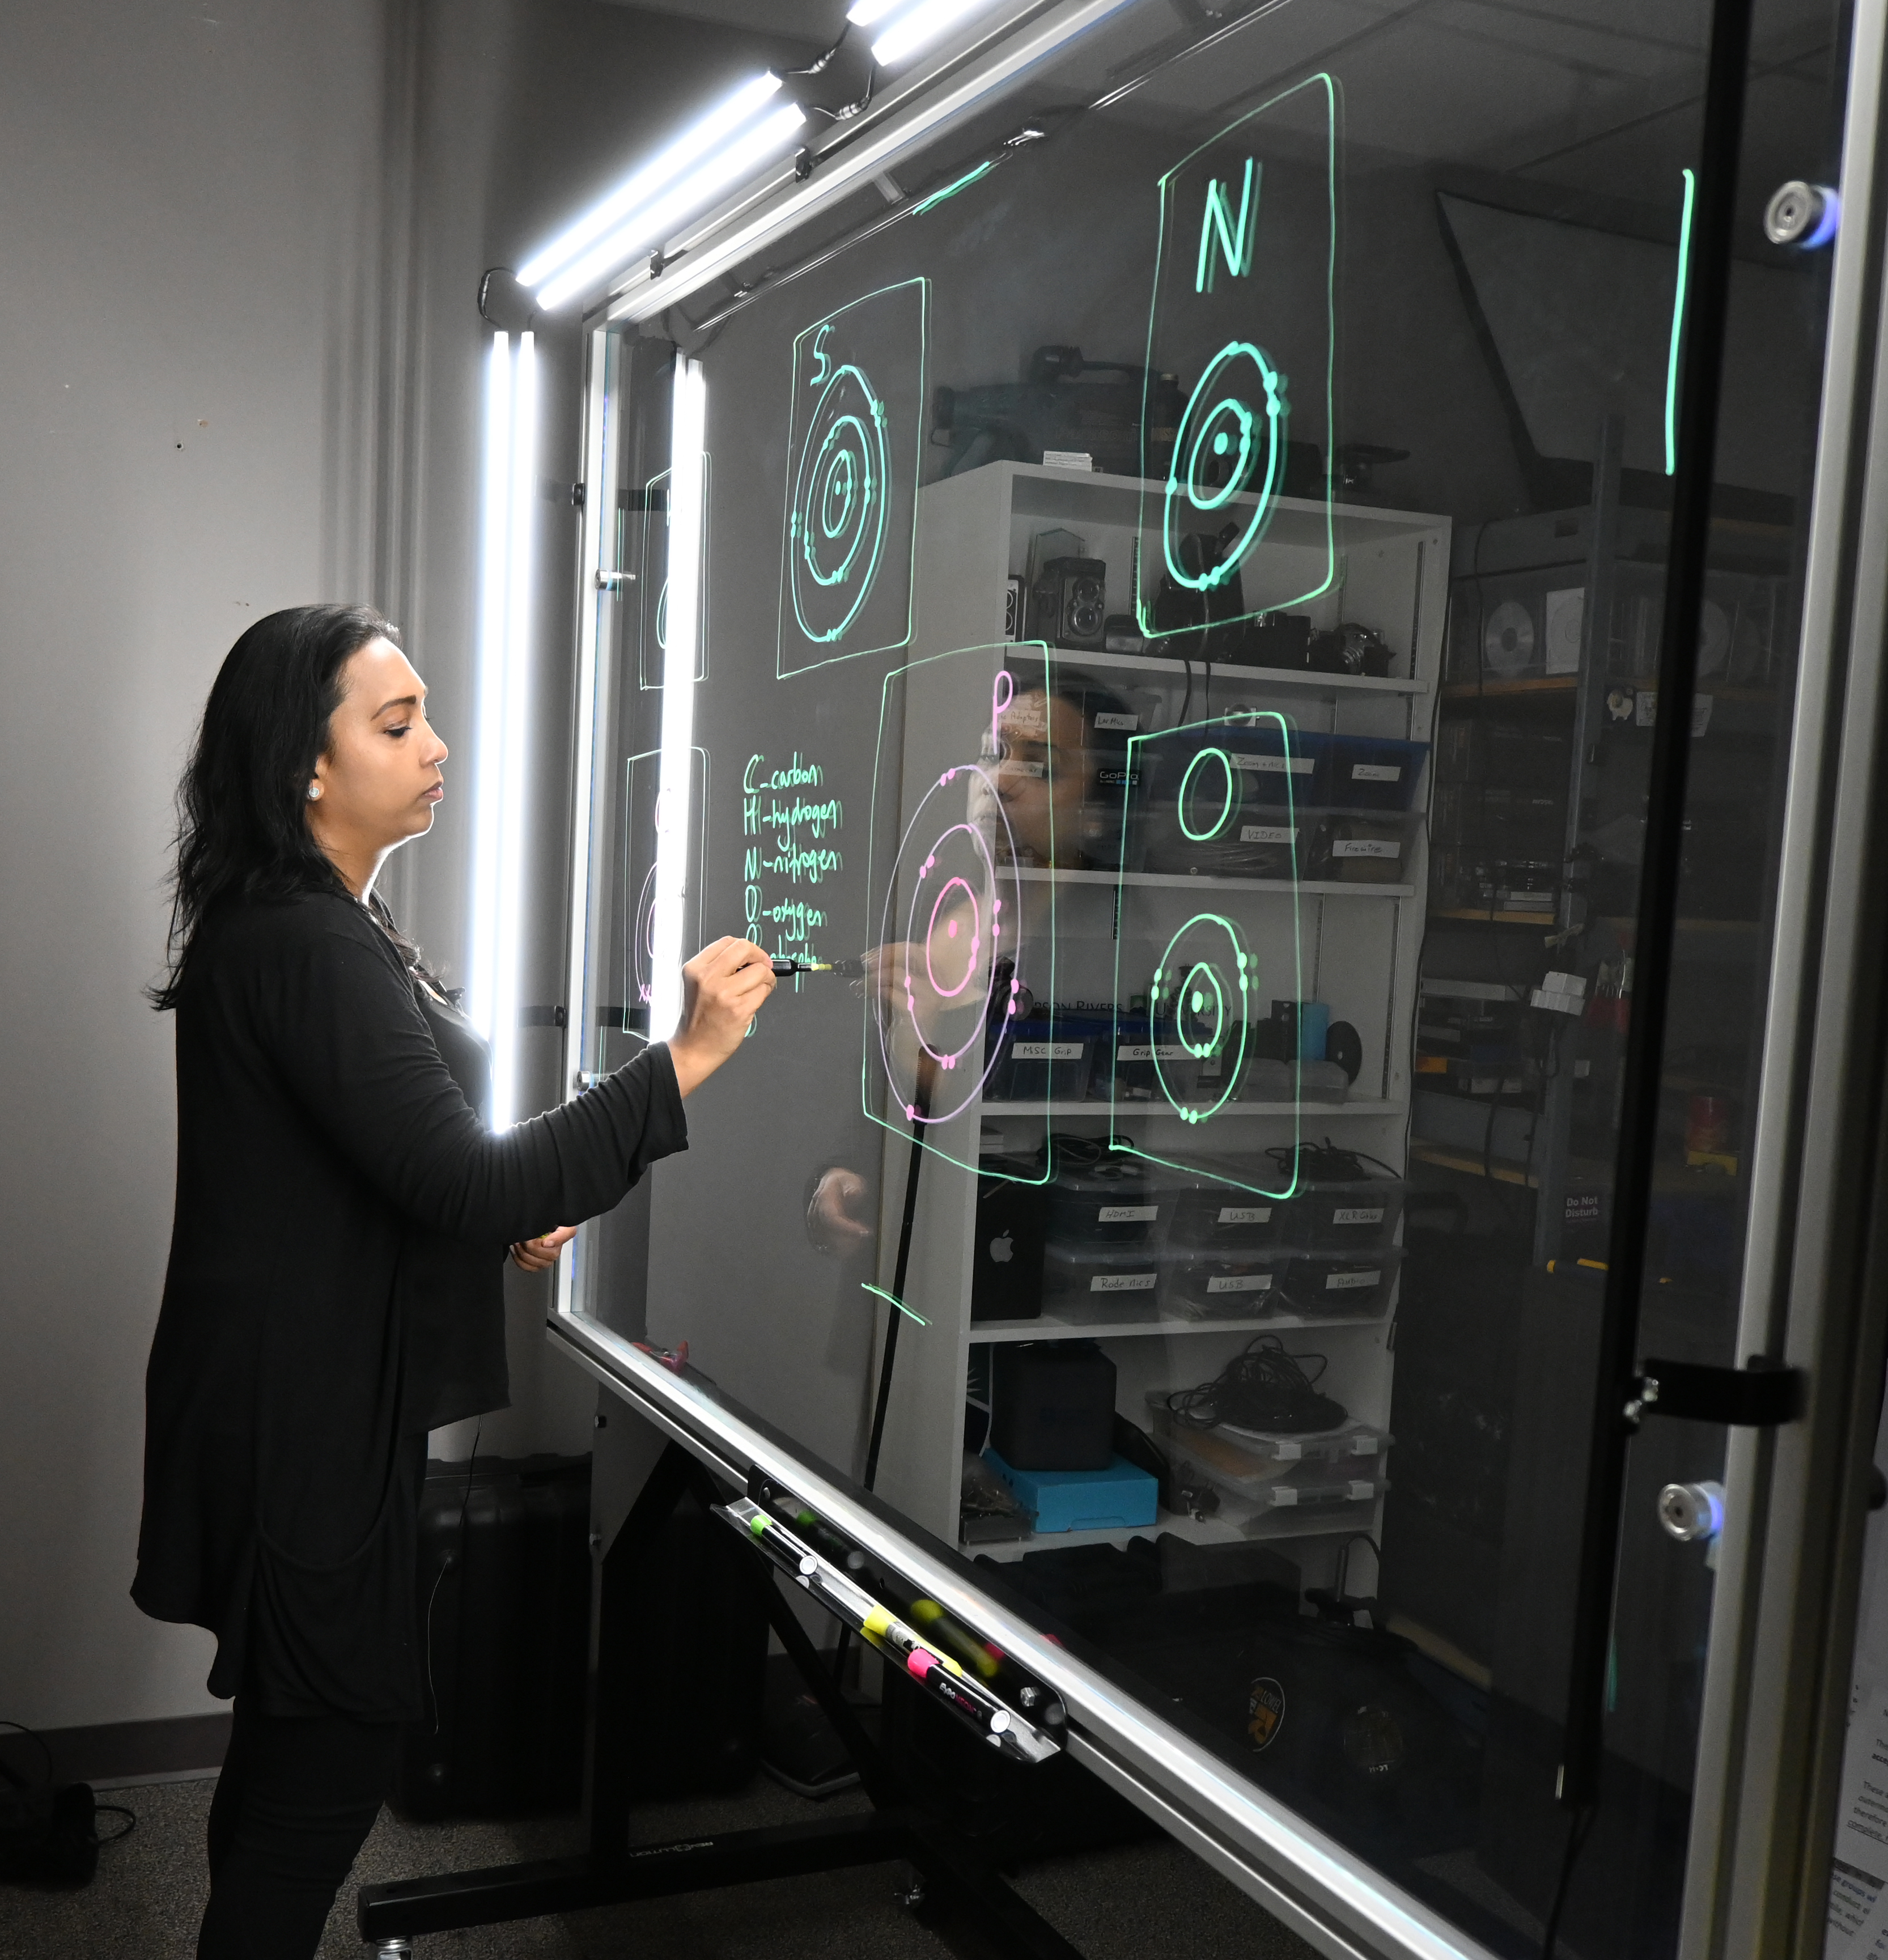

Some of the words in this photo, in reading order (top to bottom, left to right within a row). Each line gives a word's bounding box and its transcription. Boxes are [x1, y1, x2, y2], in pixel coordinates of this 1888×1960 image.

[1195, 155, 1254, 293] N
[811, 325, 831, 387] S
[992, 670, 1013, 756] P
[1100, 771, 1138, 780] GoPo
[1178, 748, 1232, 841] O
[1247, 829, 1282, 840] VIDEO
[1132, 1047, 1150, 1059] Grip
[1567, 1197, 1579, 1207] Do
[1581, 1196, 1598, 1205] Not
[1105, 1209, 1135, 1219] HDMI
[1229, 1211, 1255, 1221] USB
[1565, 1207, 1598, 1217] Disturb
[1101, 1277, 1125, 1288] Rode
[1219, 1279, 1244, 1291] USB
